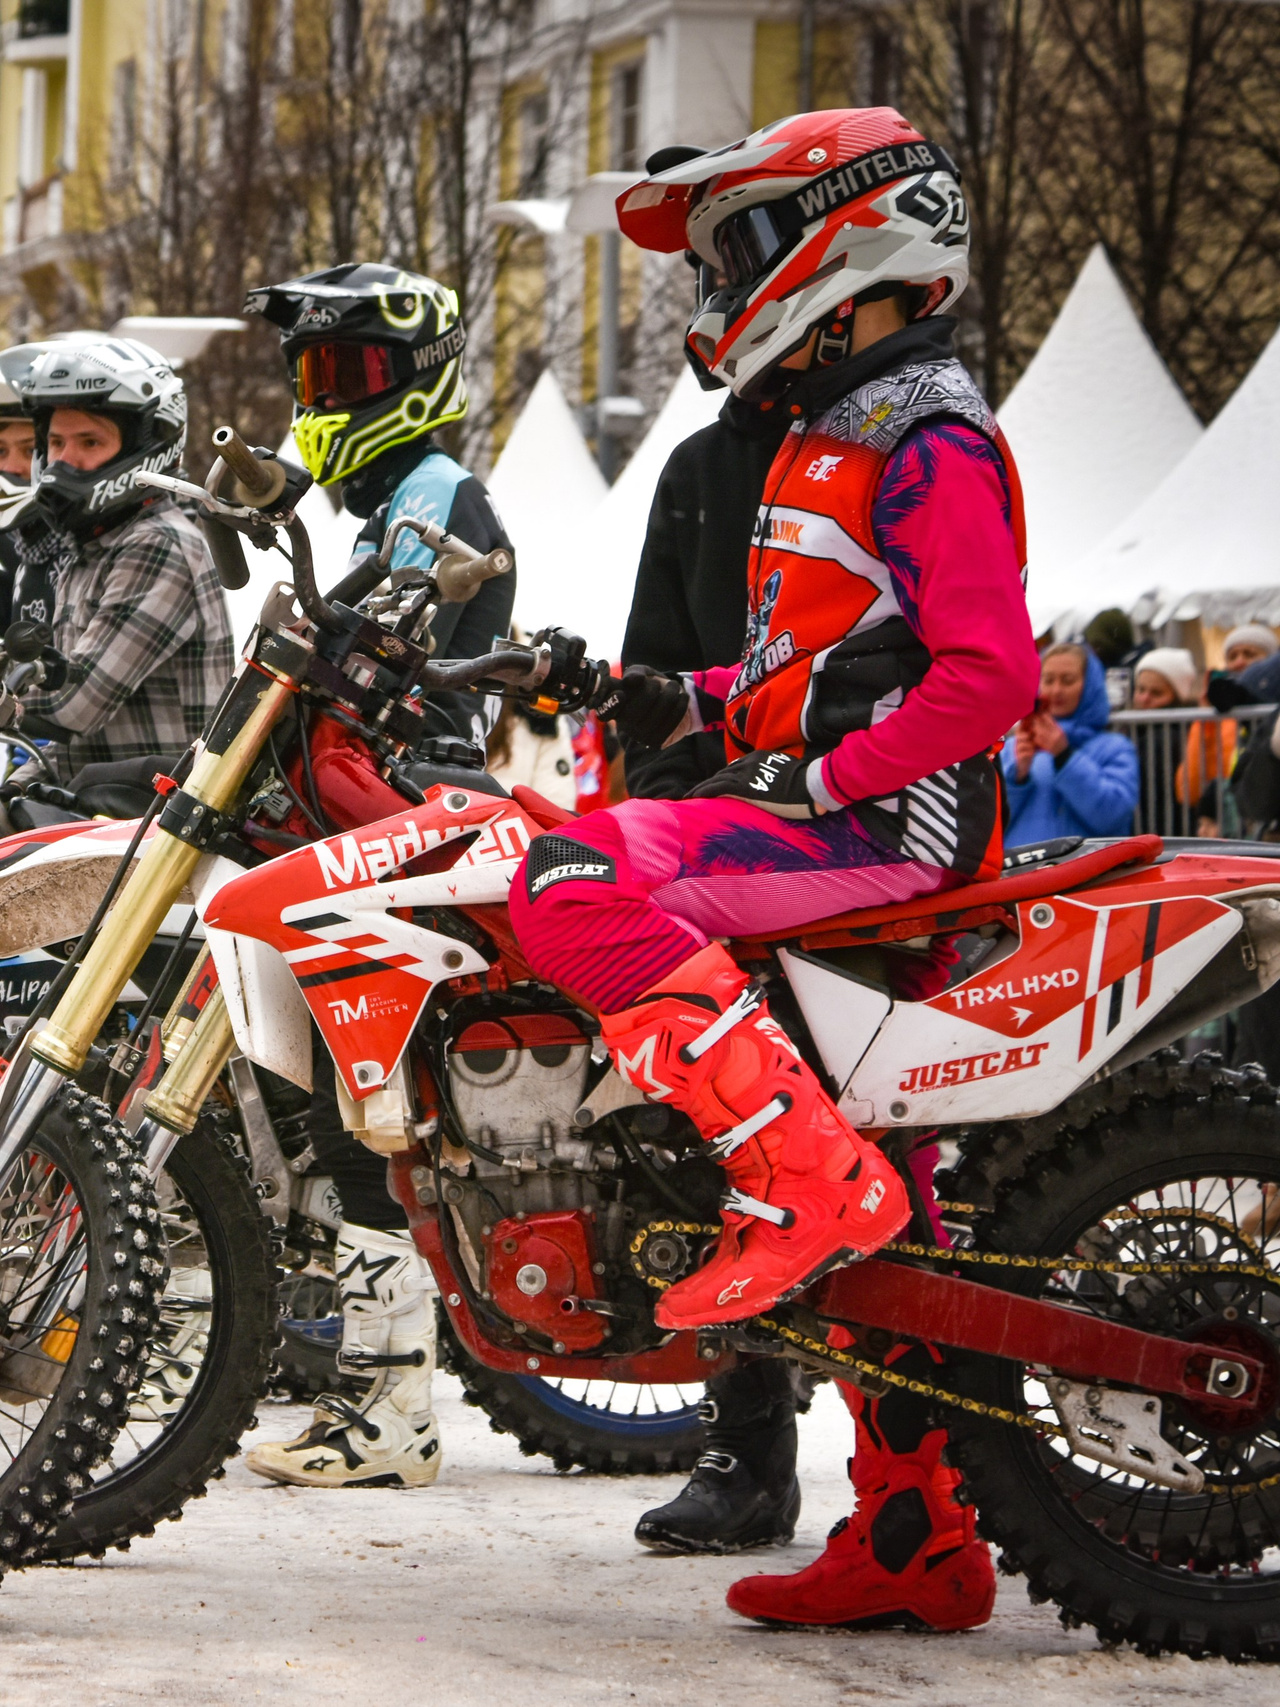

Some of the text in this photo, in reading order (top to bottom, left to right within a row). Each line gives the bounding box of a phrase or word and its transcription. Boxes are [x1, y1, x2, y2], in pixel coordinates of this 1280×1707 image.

[797, 144, 936, 219] WHITELAB
[805, 454, 845, 482] ETC
[749, 753, 792, 792] ALIPA
[531, 863, 609, 893] JUSTCAT
[950, 967, 1081, 1010] TRXLHXD
[328, 995, 369, 1026] TM
[898, 1042, 1050, 1092] JUSTCAT
[910, 1082, 951, 1096] RACING
